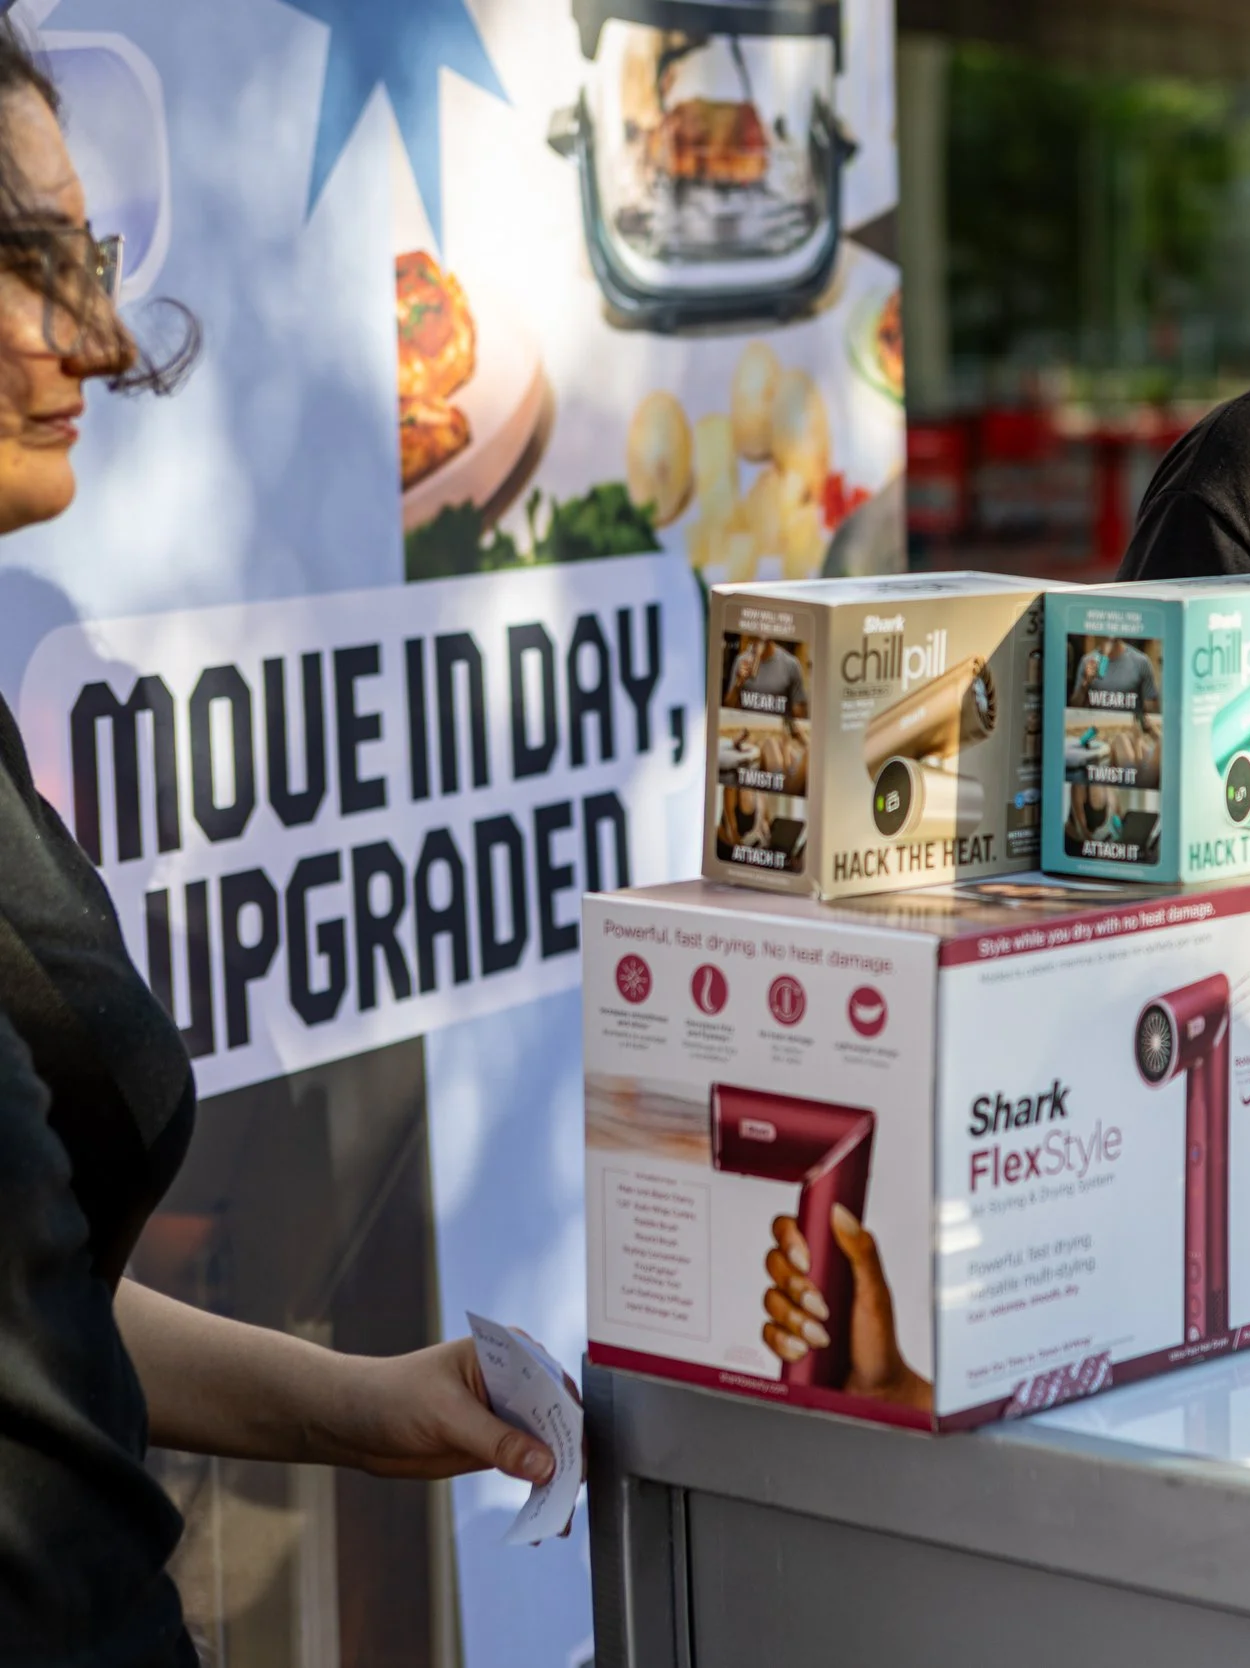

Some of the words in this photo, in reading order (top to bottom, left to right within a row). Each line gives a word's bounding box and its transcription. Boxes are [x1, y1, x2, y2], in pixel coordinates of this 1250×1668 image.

[863, 614, 905, 633] Shark
[406, 631, 490, 803] IN
[507, 604, 686, 781] DAY,
[741, 690, 774, 709] WEAR
[775, 696, 788, 710] IT
[1088, 689, 1123, 707] WEAR
[1125, 693, 1138, 708] IT
[739, 768, 772, 789] TWIST
[773, 772, 785, 790] IT
[1087, 765, 1124, 784] TWIST
[1125, 768, 1137, 784] IT
[732, 845, 773, 867] ATTACH
[774, 851, 787, 868] IT
[834, 847, 890, 882] HACK
[895, 842, 936, 873] THE
[943, 835, 997, 867] HEAT.
[1082, 840, 1126, 859] ATTACH
[1126, 845, 1139, 861] IT
[1189, 839, 1236, 871] HACK
[145, 790, 632, 1059] UPGRADED
[978, 936, 1011, 958] Style
[1014, 929, 1045, 950] while
[1049, 928, 1070, 948] you
[1074, 922, 1093, 942] dry
[1097, 916, 1120, 935] with
[1124, 915, 1138, 930] no
[1140, 909, 1165, 927] heat
[1167, 902, 1216, 923] damage.
[603, 918, 672, 947] Powerful,
[675, 925, 702, 948] fast
[762, 940, 786, 960] No
[791, 943, 823, 964] heat
[969, 1078, 1071, 1137] Shark
[969, 1118, 1123, 1194] FlexStyle
[1078, 1174, 1115, 1194] System
[1028, 1242, 1050, 1262] fast
